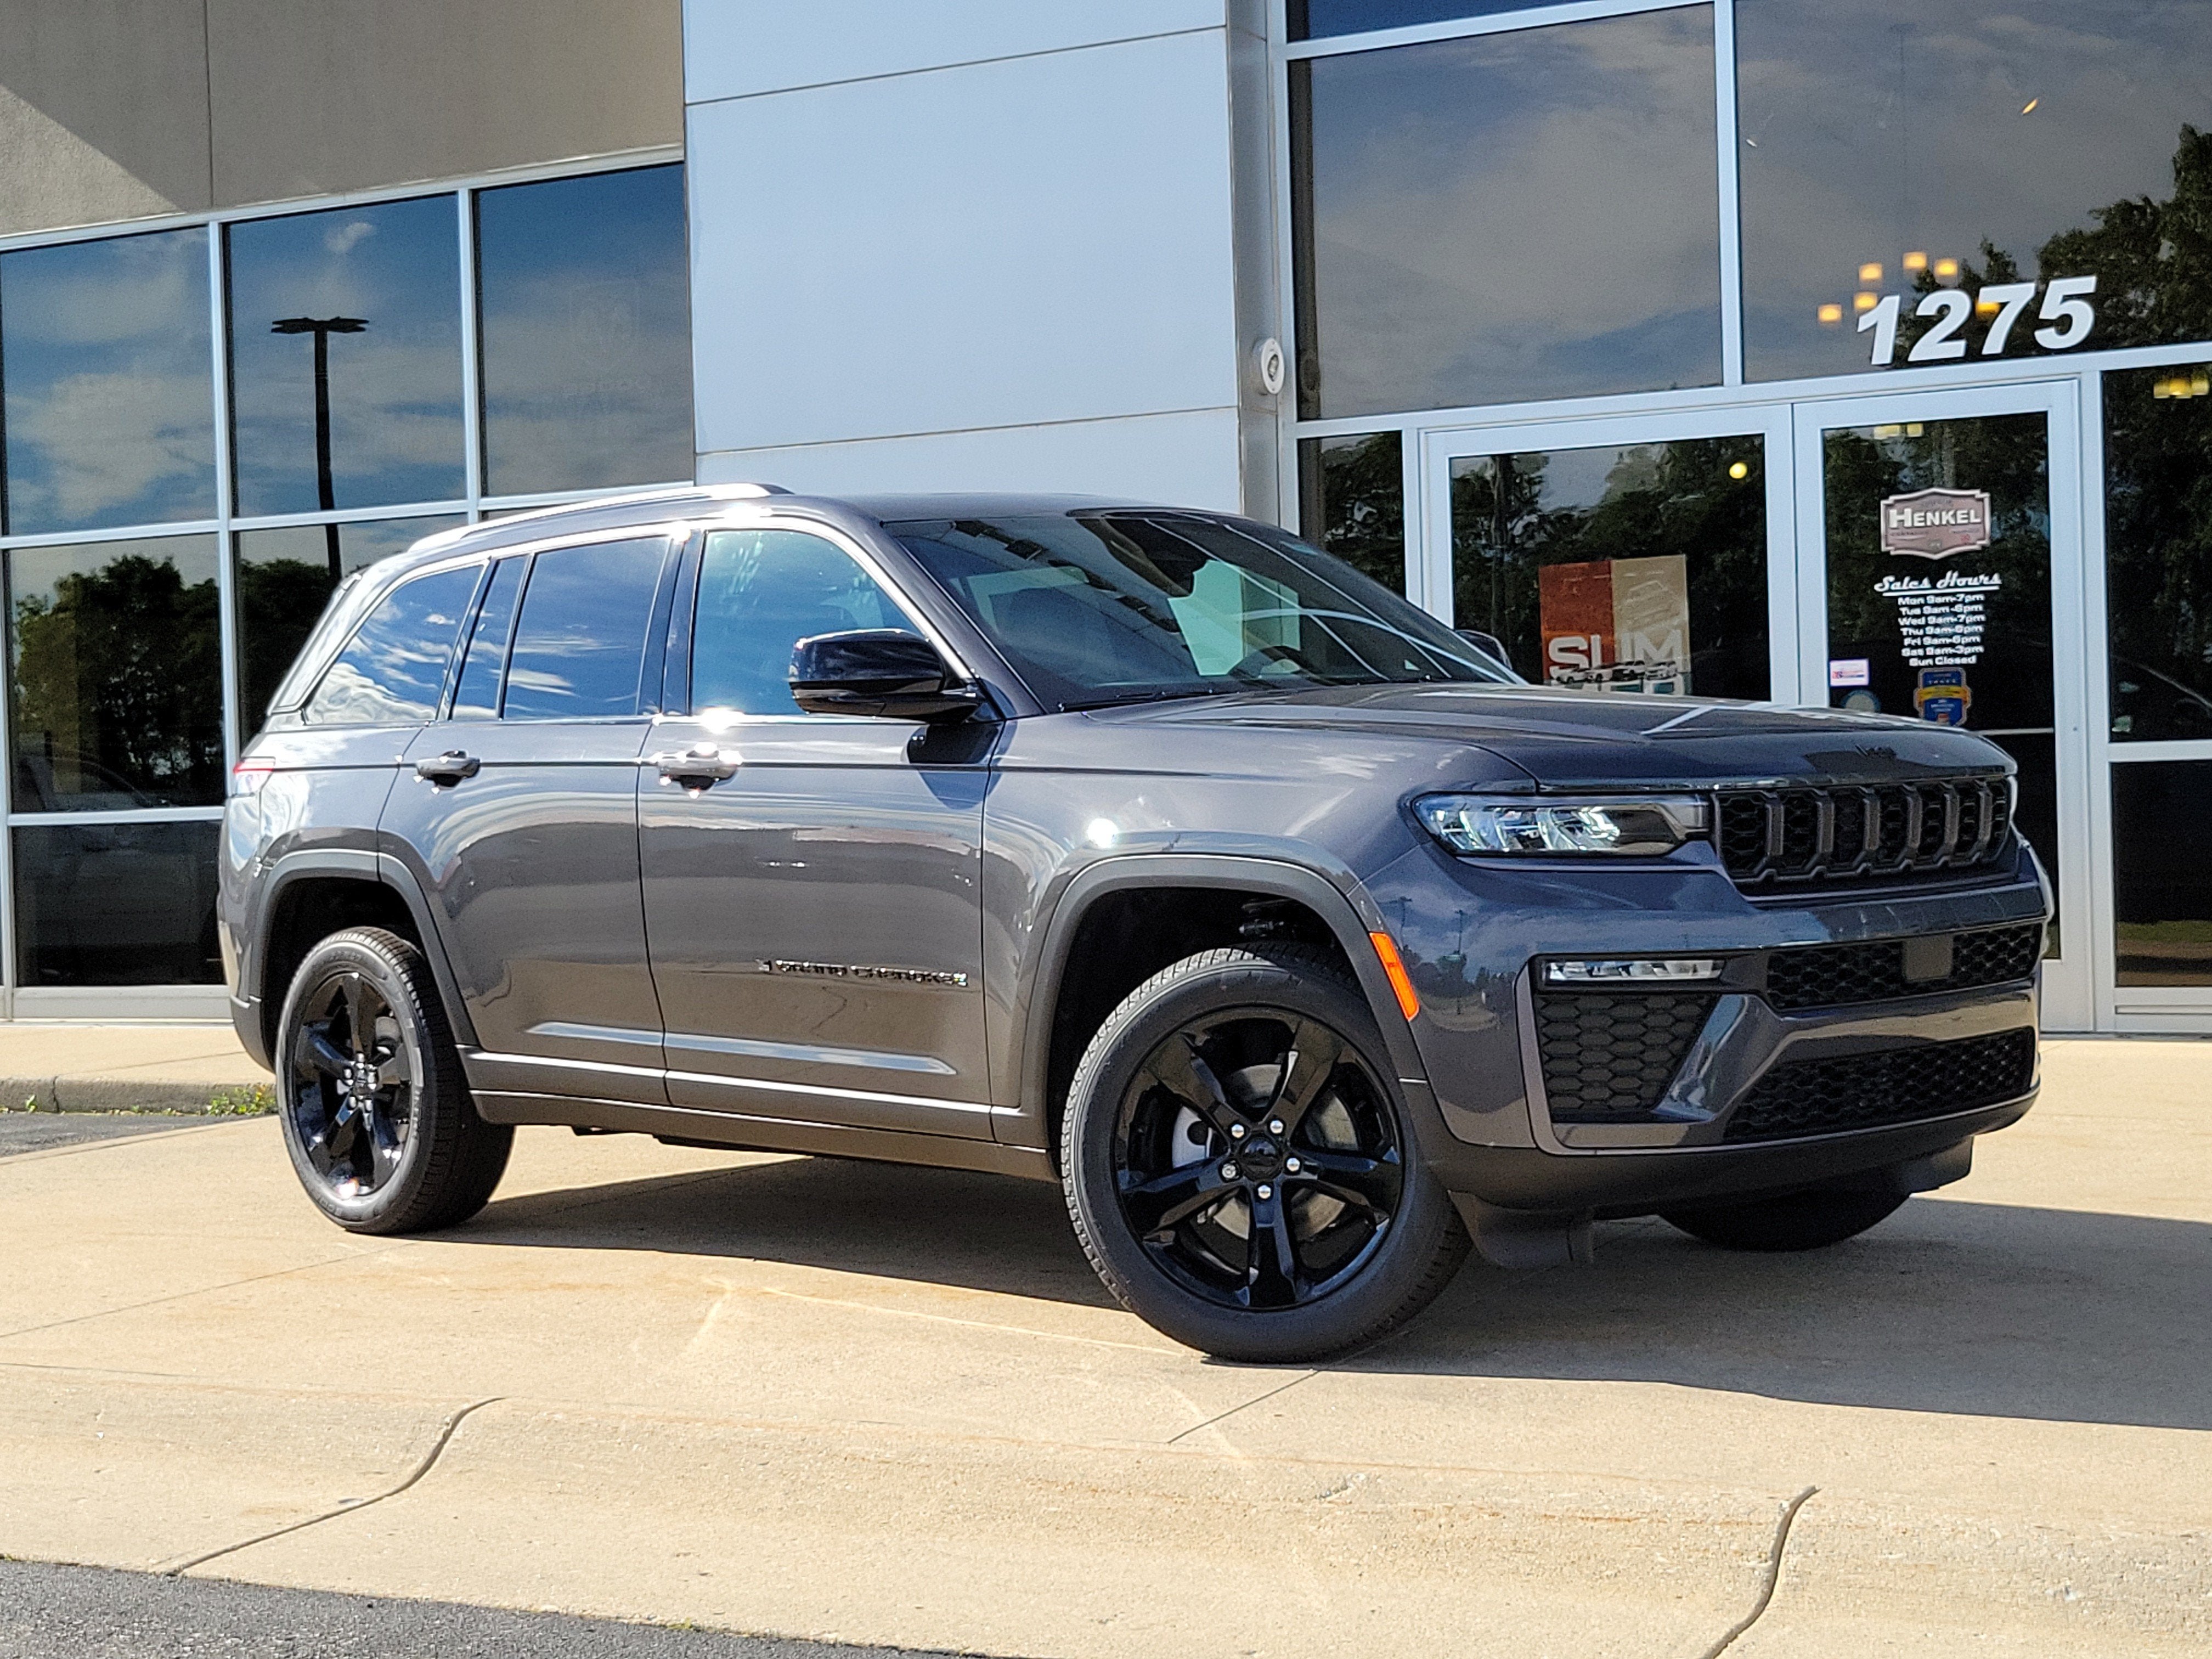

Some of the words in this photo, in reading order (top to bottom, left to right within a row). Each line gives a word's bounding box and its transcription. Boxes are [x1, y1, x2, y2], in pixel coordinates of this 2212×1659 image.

[1857, 275, 2097, 365] 1275
[1889, 508, 1982, 528] HENKEL
[1874, 575, 1932, 592] Sales
[1936, 570, 2002, 589] Hours
[1898, 597, 1925, 605] Mon
[1899, 607, 1921, 616] Tue
[1898, 616, 1926, 625] Wed
[1900, 627, 1923, 636] Thu
[1904, 637, 1921, 646] Fri
[1901, 647, 1924, 657] Sat
[1909, 658, 1933, 666] Sun
[1935, 656, 1976, 664] Closed
